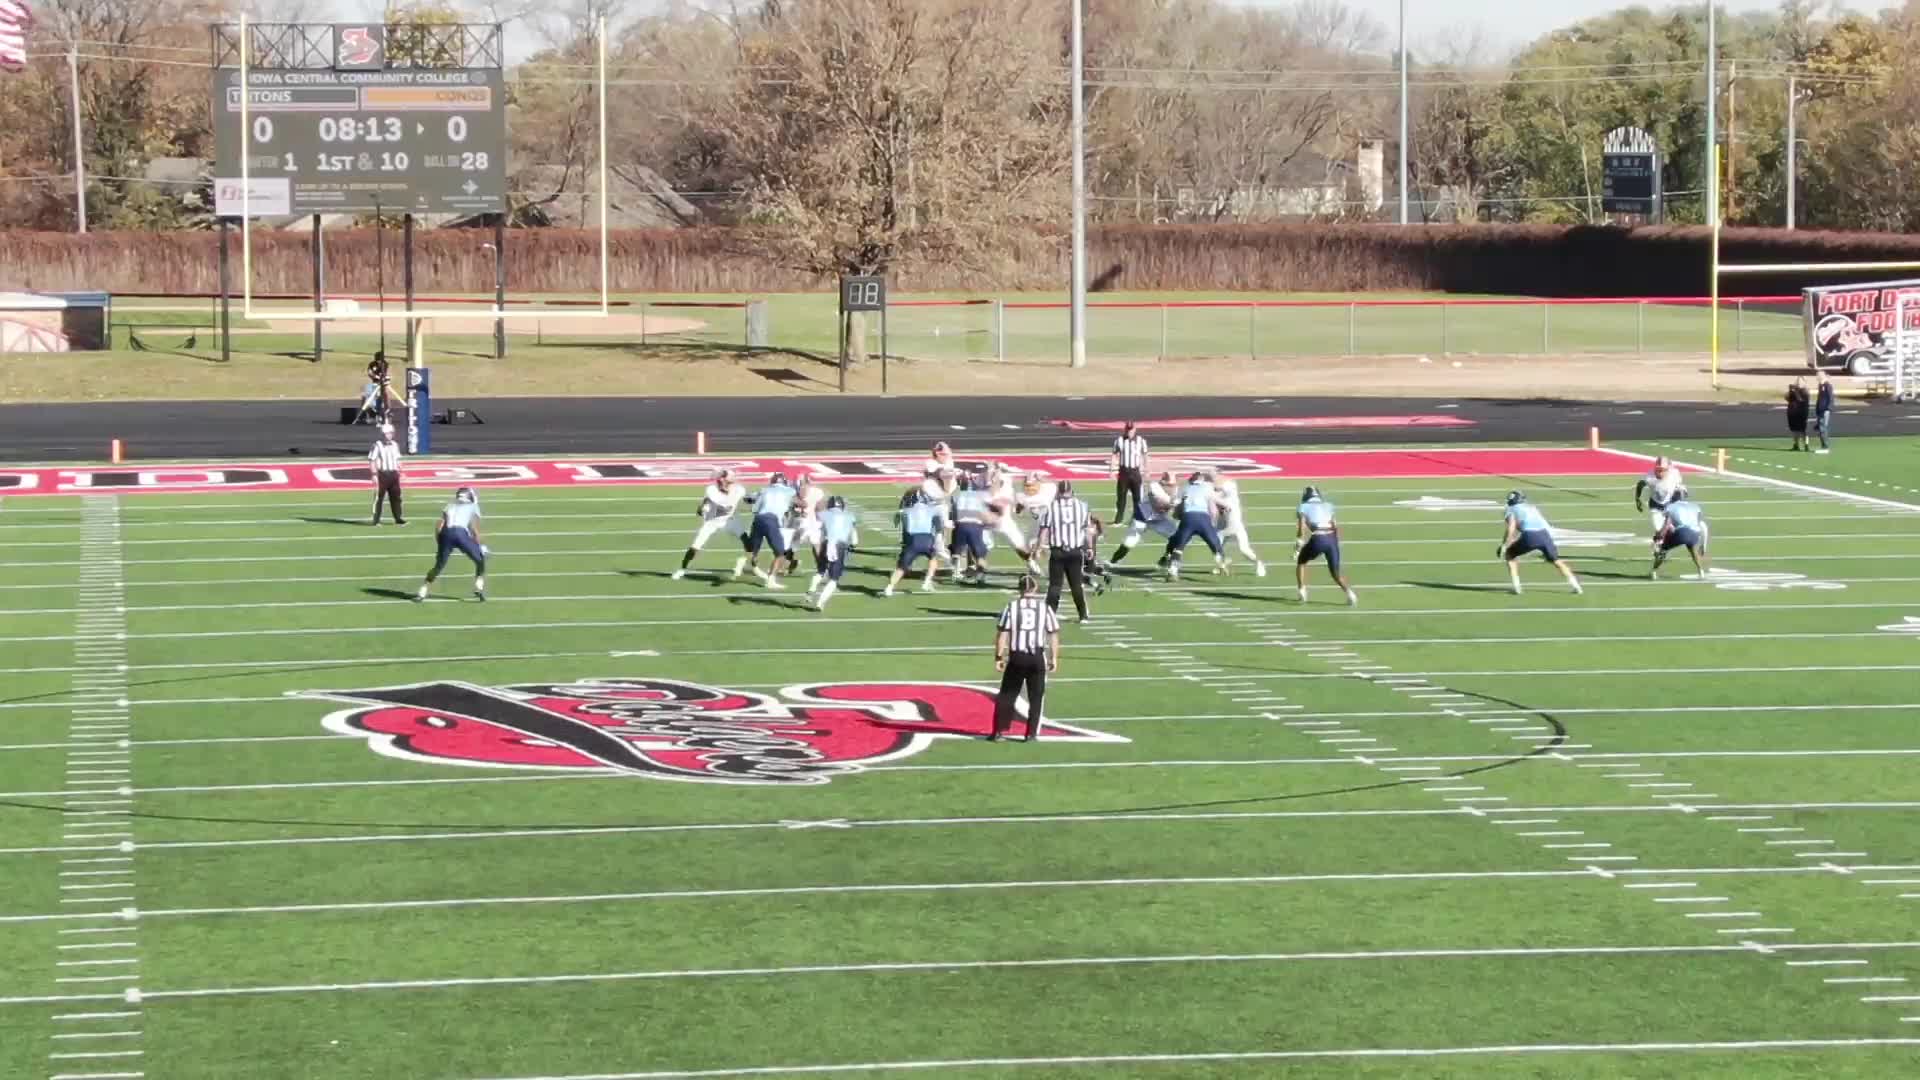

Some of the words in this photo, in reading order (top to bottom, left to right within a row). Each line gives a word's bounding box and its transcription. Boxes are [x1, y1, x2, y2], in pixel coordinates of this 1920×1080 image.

[248, 73, 282, 84] IOWA
[284, 73, 338, 84] CENTRAL
[340, 73, 413, 84] COMMUNITY
[416, 73, 469, 83] COLLEGE
[253, 116, 273, 142] 0
[318, 116, 402, 142] 08:13
[447, 115, 467, 142] 0
[283, 152, 299, 171] 1
[316, 152, 355, 171] 1ST
[357, 153, 374, 171] &
[380, 152, 409, 171] 10
[461, 152, 489, 170] 28
[1818, 289, 1880, 315] FORT
